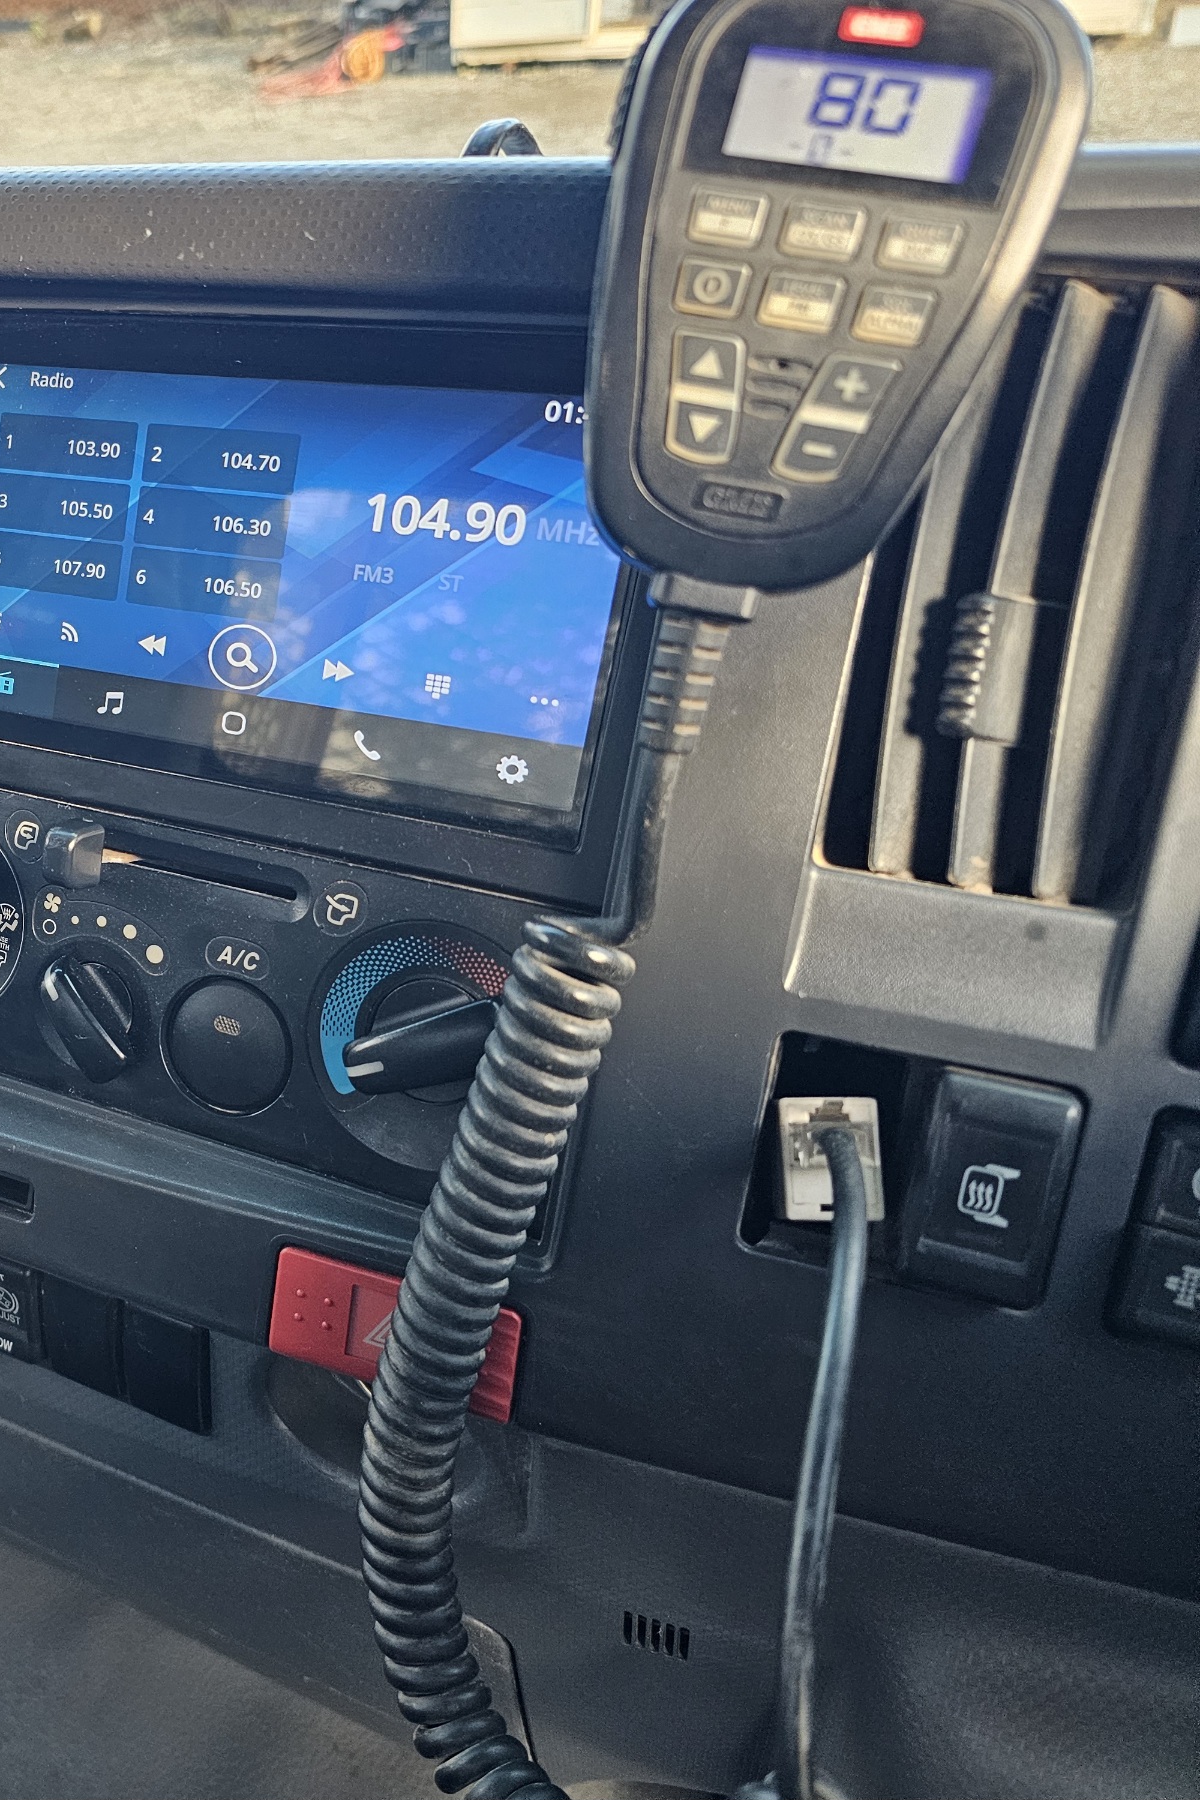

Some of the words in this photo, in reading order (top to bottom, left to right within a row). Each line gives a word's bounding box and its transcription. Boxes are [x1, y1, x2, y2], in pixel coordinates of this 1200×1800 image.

[807, 71, 921, 138] 80
[30, 371, 74, 389] Radio
[544, 400, 590, 425] 01:
[6, 434, 13, 449] 1
[67, 439, 121, 459] 103.90
[151, 446, 163, 463] 2
[221, 451, 281, 473] 104.70
[60, 500, 113, 520] 105.50
[367, 493, 527, 546] 104.90
[536, 517, 600, 547] MHz
[143, 509, 154, 524] 4
[212, 515, 272, 537] 106.30
[53, 559, 106, 579] 107.90
[353, 564, 394, 585] FM3
[135, 569, 147, 585] 6
[203, 577, 262, 599] 106.50
[438, 574, 464, 593] ST
[216, 945, 260, 971] A/C
